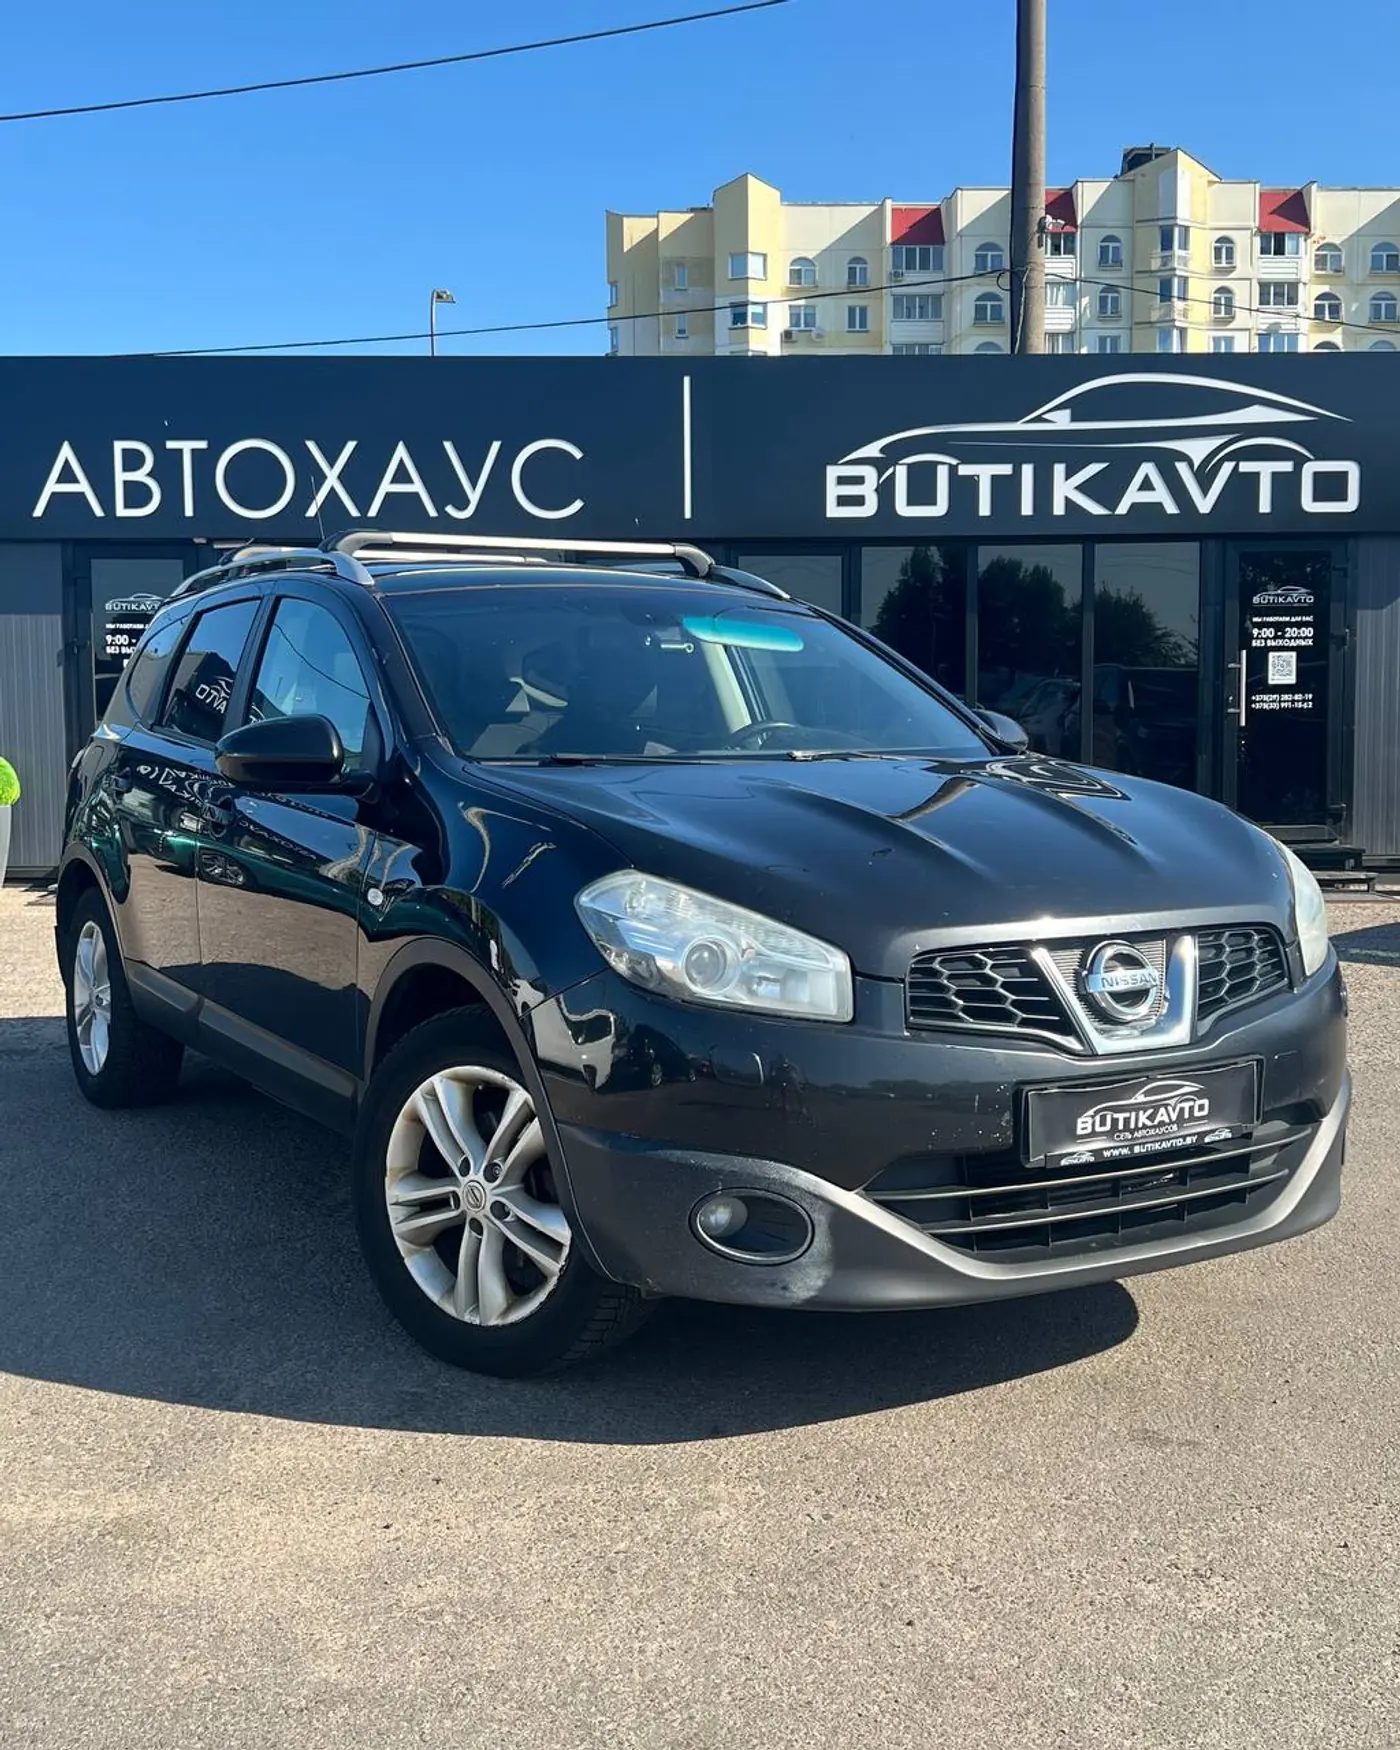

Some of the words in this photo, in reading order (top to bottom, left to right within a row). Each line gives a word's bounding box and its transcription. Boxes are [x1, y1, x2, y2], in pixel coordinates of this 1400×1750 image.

[32, 438, 586, 519] АВТОХАУС
[825, 459, 1362, 518] BUTIKAVTO
[1252, 595, 1315, 604] BUTIKAVTO
[105, 602, 159, 611] BUTIKAVT
[1252, 627, 1275, 638] 9:00
[1284, 627, 1314, 638] 20:00
[105, 634, 129, 645] 9:00
[1251, 639, 1265, 647] БЕЗ
[1266, 638, 1314, 647] ВЫХОДНЫХ
[1101, 972, 1157, 988] NISSAN
[1076, 1098, 1209, 1135] BUTIKAVTO
[1133, 1135, 1198, 1154] BUTIKAVTO.BY
